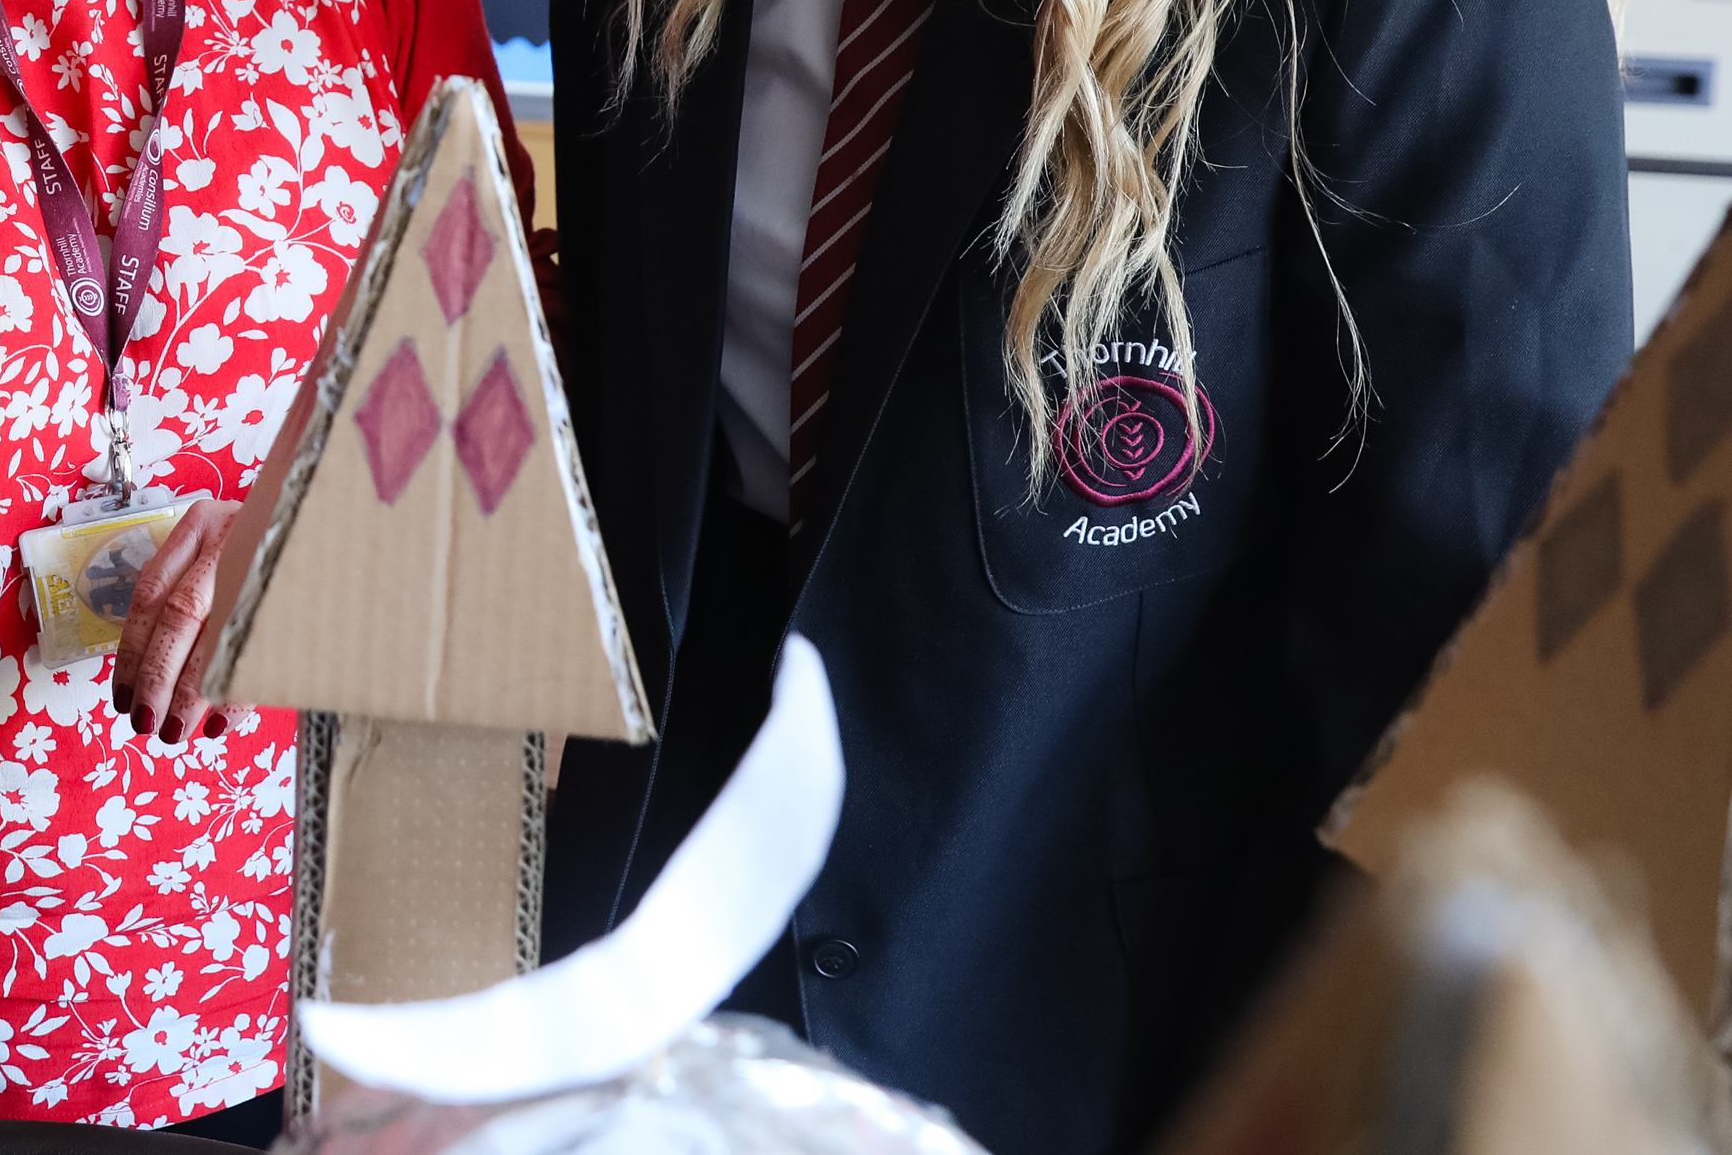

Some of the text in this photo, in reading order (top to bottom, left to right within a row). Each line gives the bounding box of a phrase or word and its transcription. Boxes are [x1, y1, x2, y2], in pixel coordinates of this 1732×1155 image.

[34, 138, 62, 196] STAFF
[133, 163, 149, 203] Academies
[138, 168, 159, 232] Consilium
[55, 236, 77, 277] Thornhill
[66, 232, 87, 275] Academy
[114, 254, 140, 316] STAFF
[1040, 338, 1197, 379] Tornhi
[1063, 491, 1201, 547] Academy
